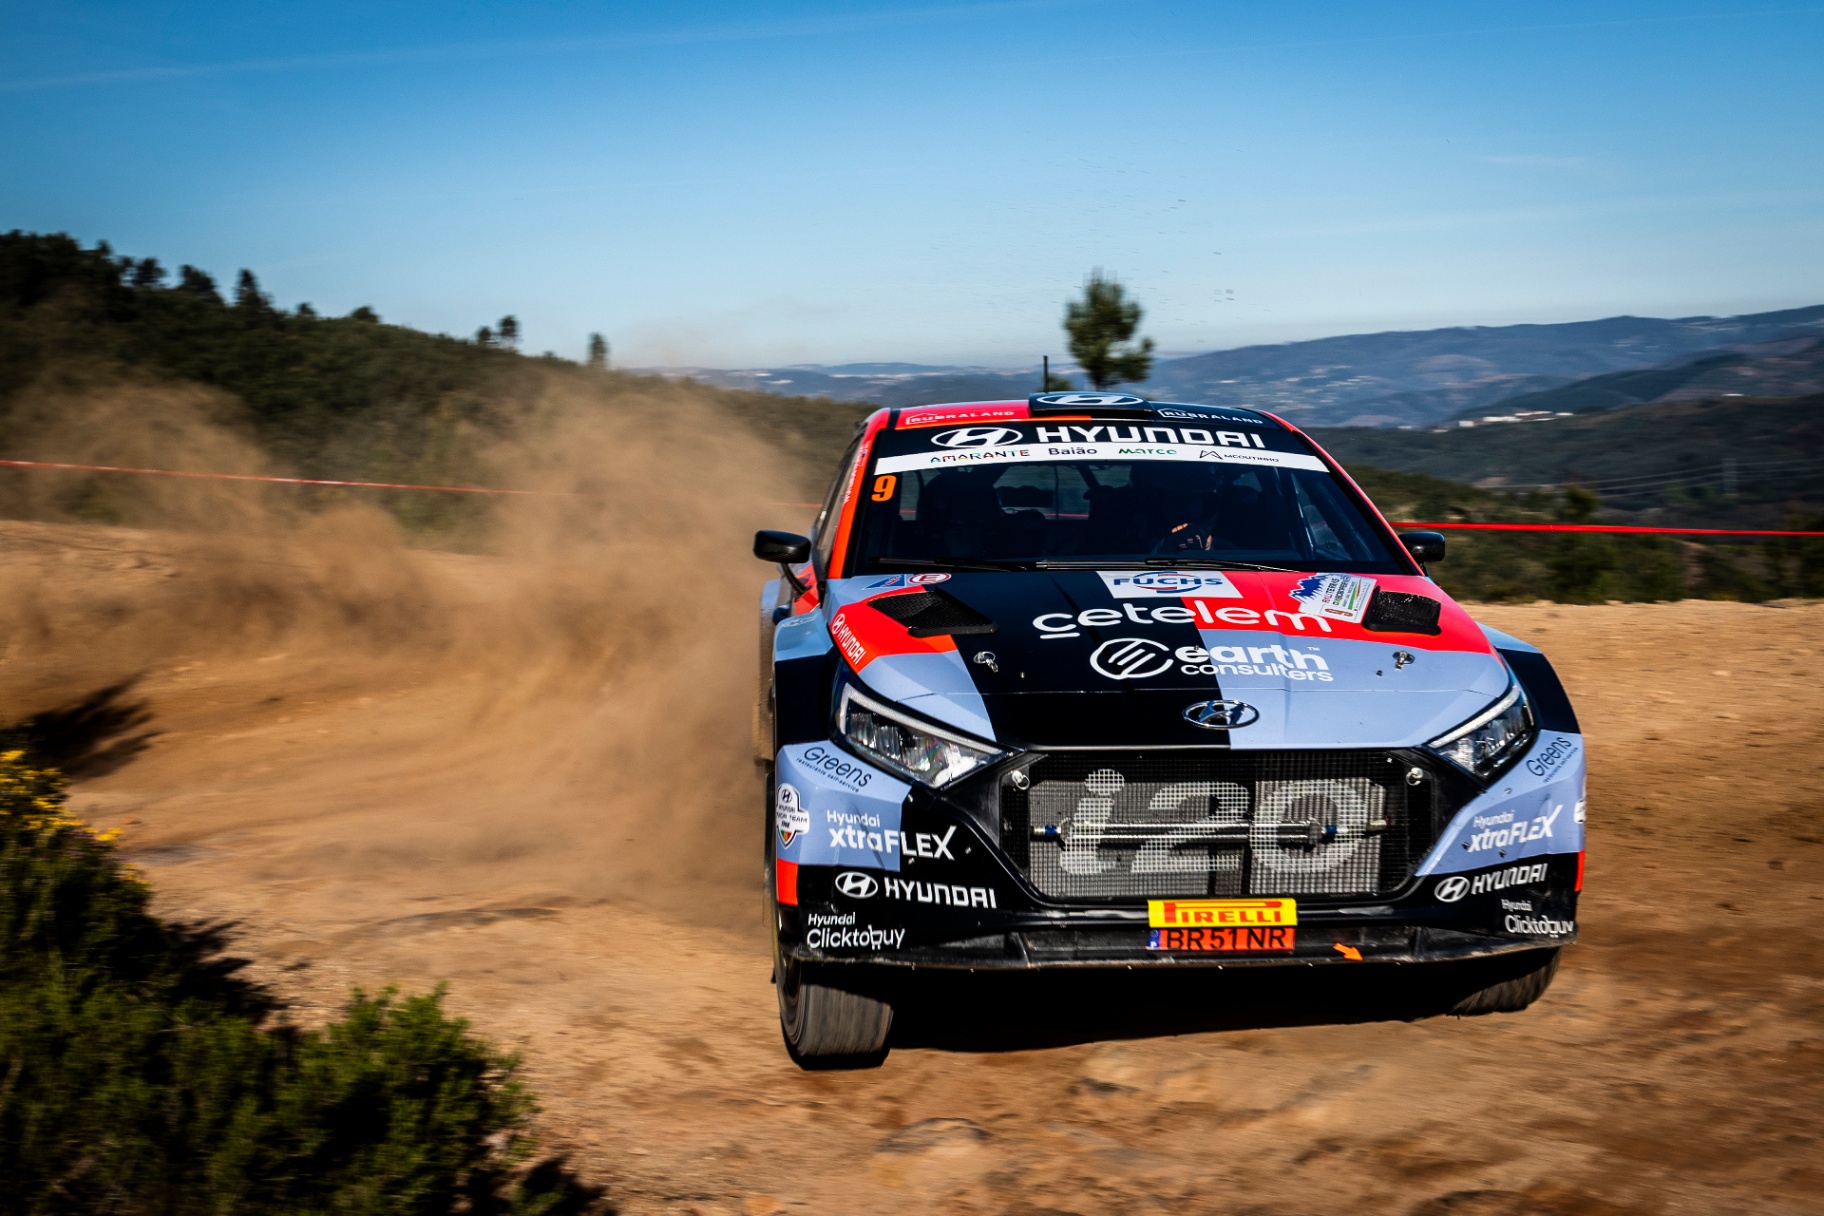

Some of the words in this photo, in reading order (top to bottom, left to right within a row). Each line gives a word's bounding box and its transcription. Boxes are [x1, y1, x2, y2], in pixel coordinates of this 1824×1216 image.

[910, 411, 1015, 423] RUBRALAND
[1164, 410, 1263, 424] RUBRALAND
[1036, 426, 1266, 449] HYUNDAI
[930, 449, 1031, 463] AMARANTE
[1048, 446, 1098, 456] Baião
[871, 475, 897, 502] 9
[1113, 577, 1223, 586] FUCHS
[1032, 600, 1333, 639] cetelem
[837, 624, 867, 665] HYUNDAI
[1174, 645, 1330, 671] earth
[1181, 662, 1334, 682] consulters
[804, 746, 872, 787] Greens
[1526, 737, 1572, 776] Greens
[827, 810, 880, 828] Hyundai
[1060, 768, 1368, 875] i20
[1468, 805, 1563, 852] xtraFLEX
[1473, 810, 1516, 829] Hyundai
[829, 825, 957, 861] xtraFLEX
[1471, 863, 1548, 895] HYUNDAI
[883, 877, 997, 909] HYUNDAI
[808, 912, 856, 927] Hyundai
[1163, 901, 1283, 923] PIRELLI
